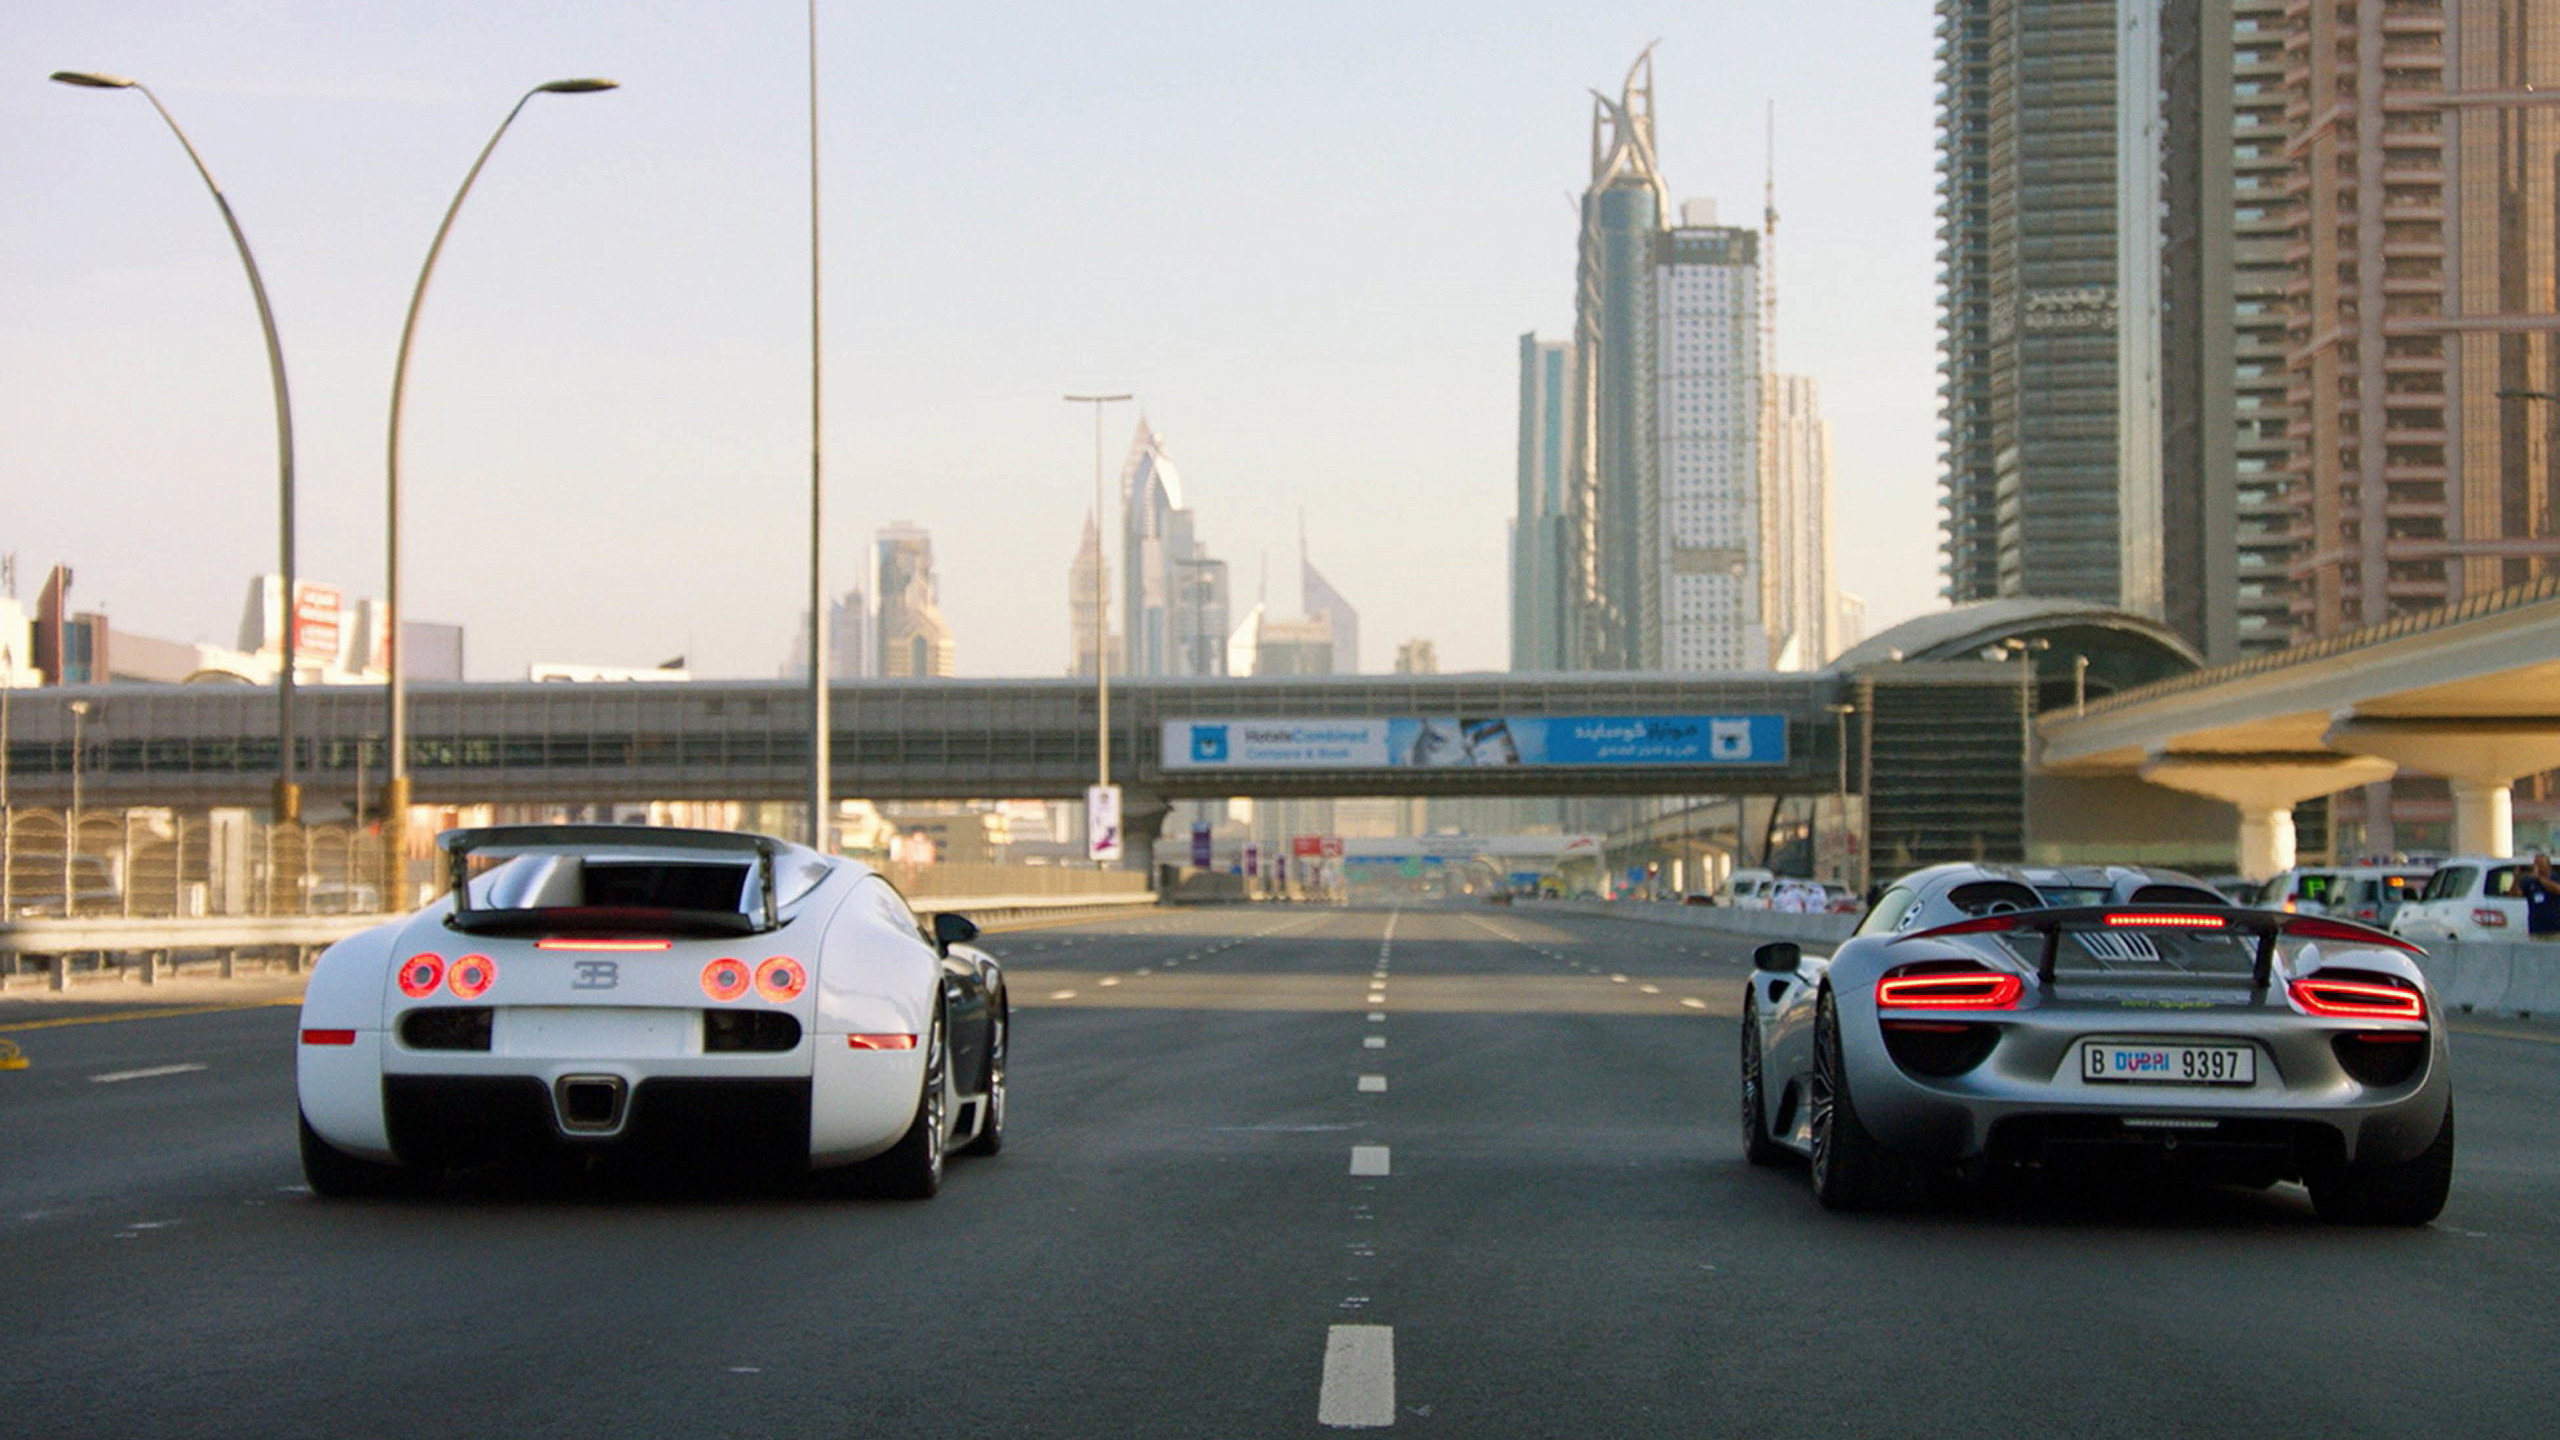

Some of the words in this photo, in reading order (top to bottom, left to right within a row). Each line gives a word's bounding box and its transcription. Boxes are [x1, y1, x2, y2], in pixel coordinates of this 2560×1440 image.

[2092, 1050, 2105, 1074] B
[2115, 1051, 2169, 1071] DUBAI
[2183, 1051, 2238, 1078] 9397
